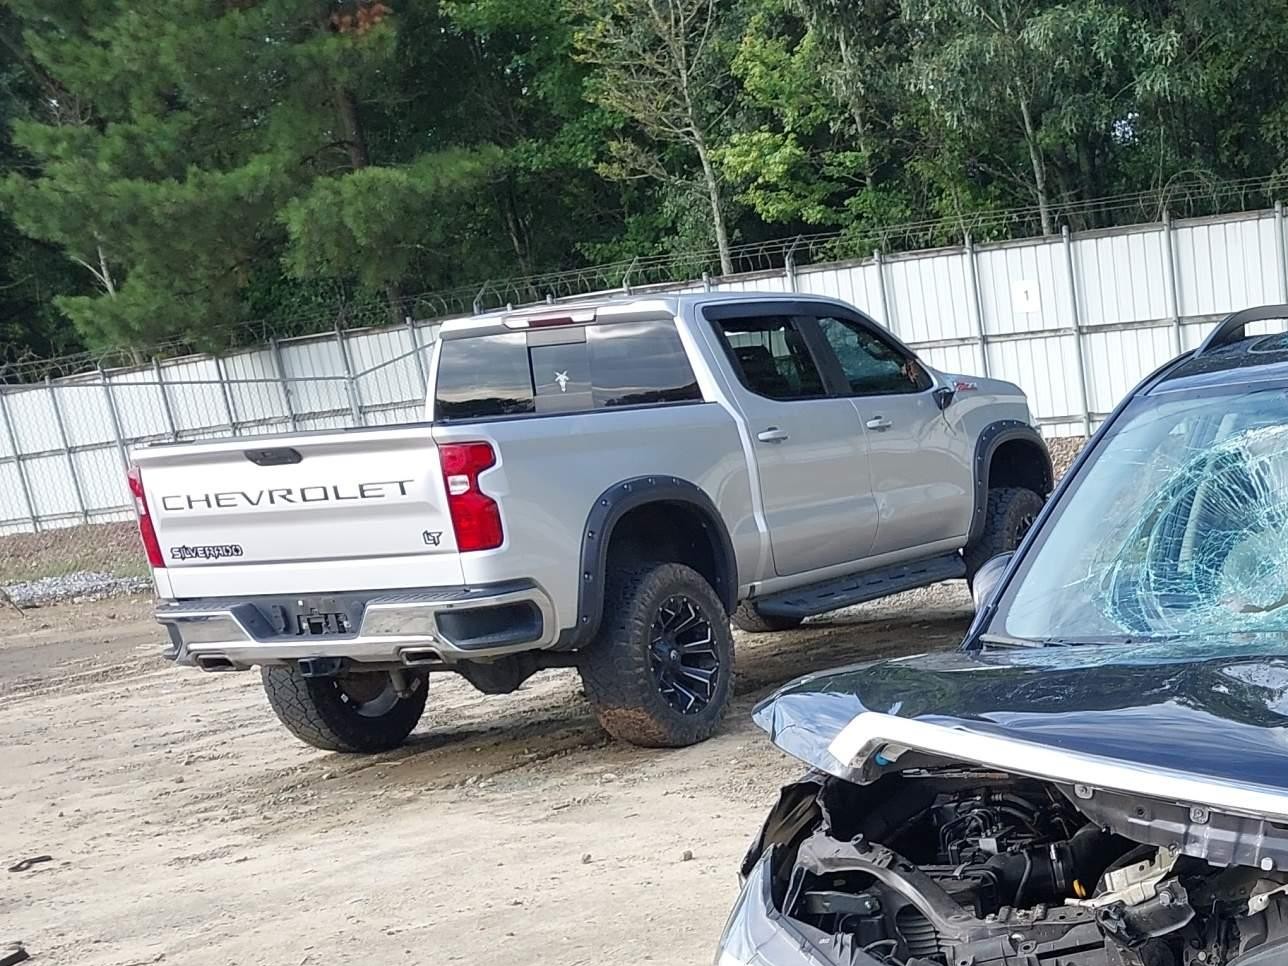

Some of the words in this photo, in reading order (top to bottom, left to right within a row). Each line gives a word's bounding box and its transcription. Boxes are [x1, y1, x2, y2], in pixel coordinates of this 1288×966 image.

[162, 479, 415, 511] CHEVROLET
[422, 530, 443, 546] LT
[170, 544, 243, 562] SILVERADO
